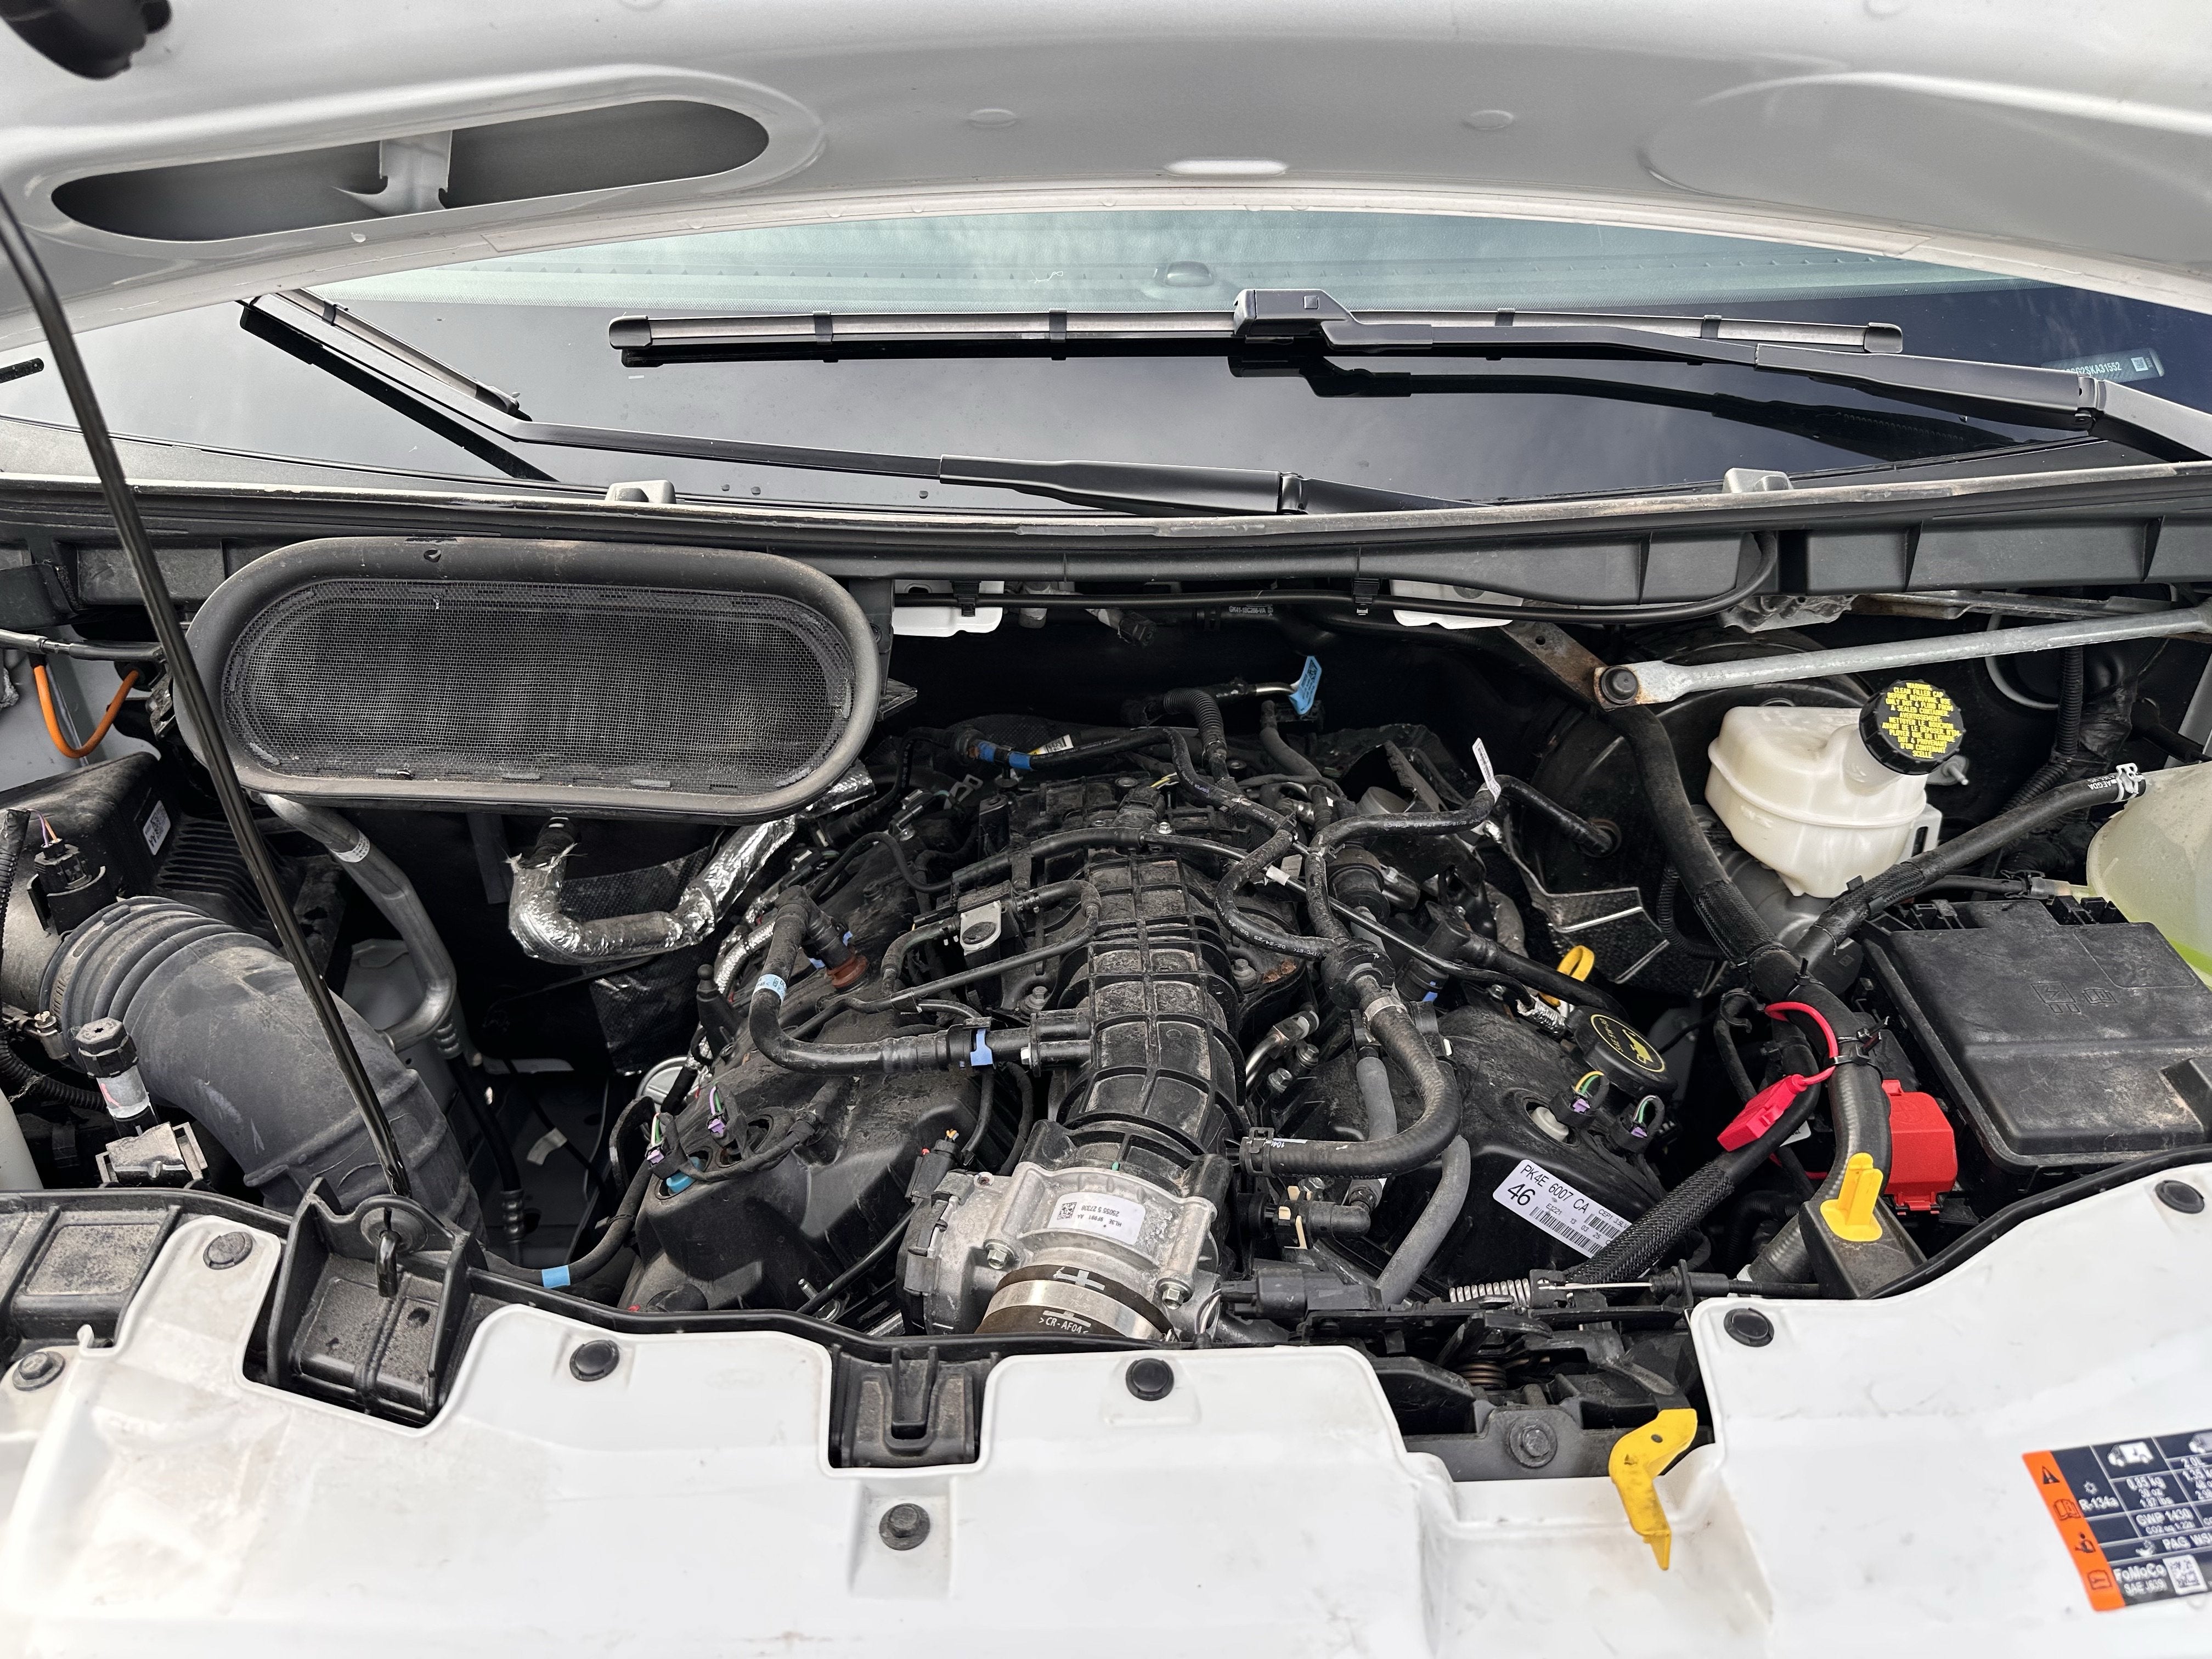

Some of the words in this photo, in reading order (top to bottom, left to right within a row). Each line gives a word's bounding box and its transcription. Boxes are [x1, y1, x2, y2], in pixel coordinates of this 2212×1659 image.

[1897, 705, 1917, 713] SEALED
[1916, 738, 1947, 747] PROVENANT
[1934, 733, 1955, 743] LIQUIDE
[2087, 780, 2112, 789] AEGDA
[1508, 1183, 1536, 1206] 46
[1520, 1164, 1549, 1187] PK4E
[1548, 1183, 1573, 1201] 6007
[1573, 1199, 1589, 1214] CA
[1599, 1209, 1613, 1220] CEP1
[1109, 1219, 1122, 1227] HL3E
[2147, 1475, 2166, 1489] kg
[2079, 1497, 2119, 1512] R-134a
[2136, 1511, 2165, 1527] GWP
[2165, 1508, 2194, 1522] 1430
[2145, 1525, 2164, 1535] CO2
[2162, 1536, 2191, 1551] PAG
[2113, 1563, 2167, 1583] FoMoCo
[2124, 1582, 2146, 1596] SAE
